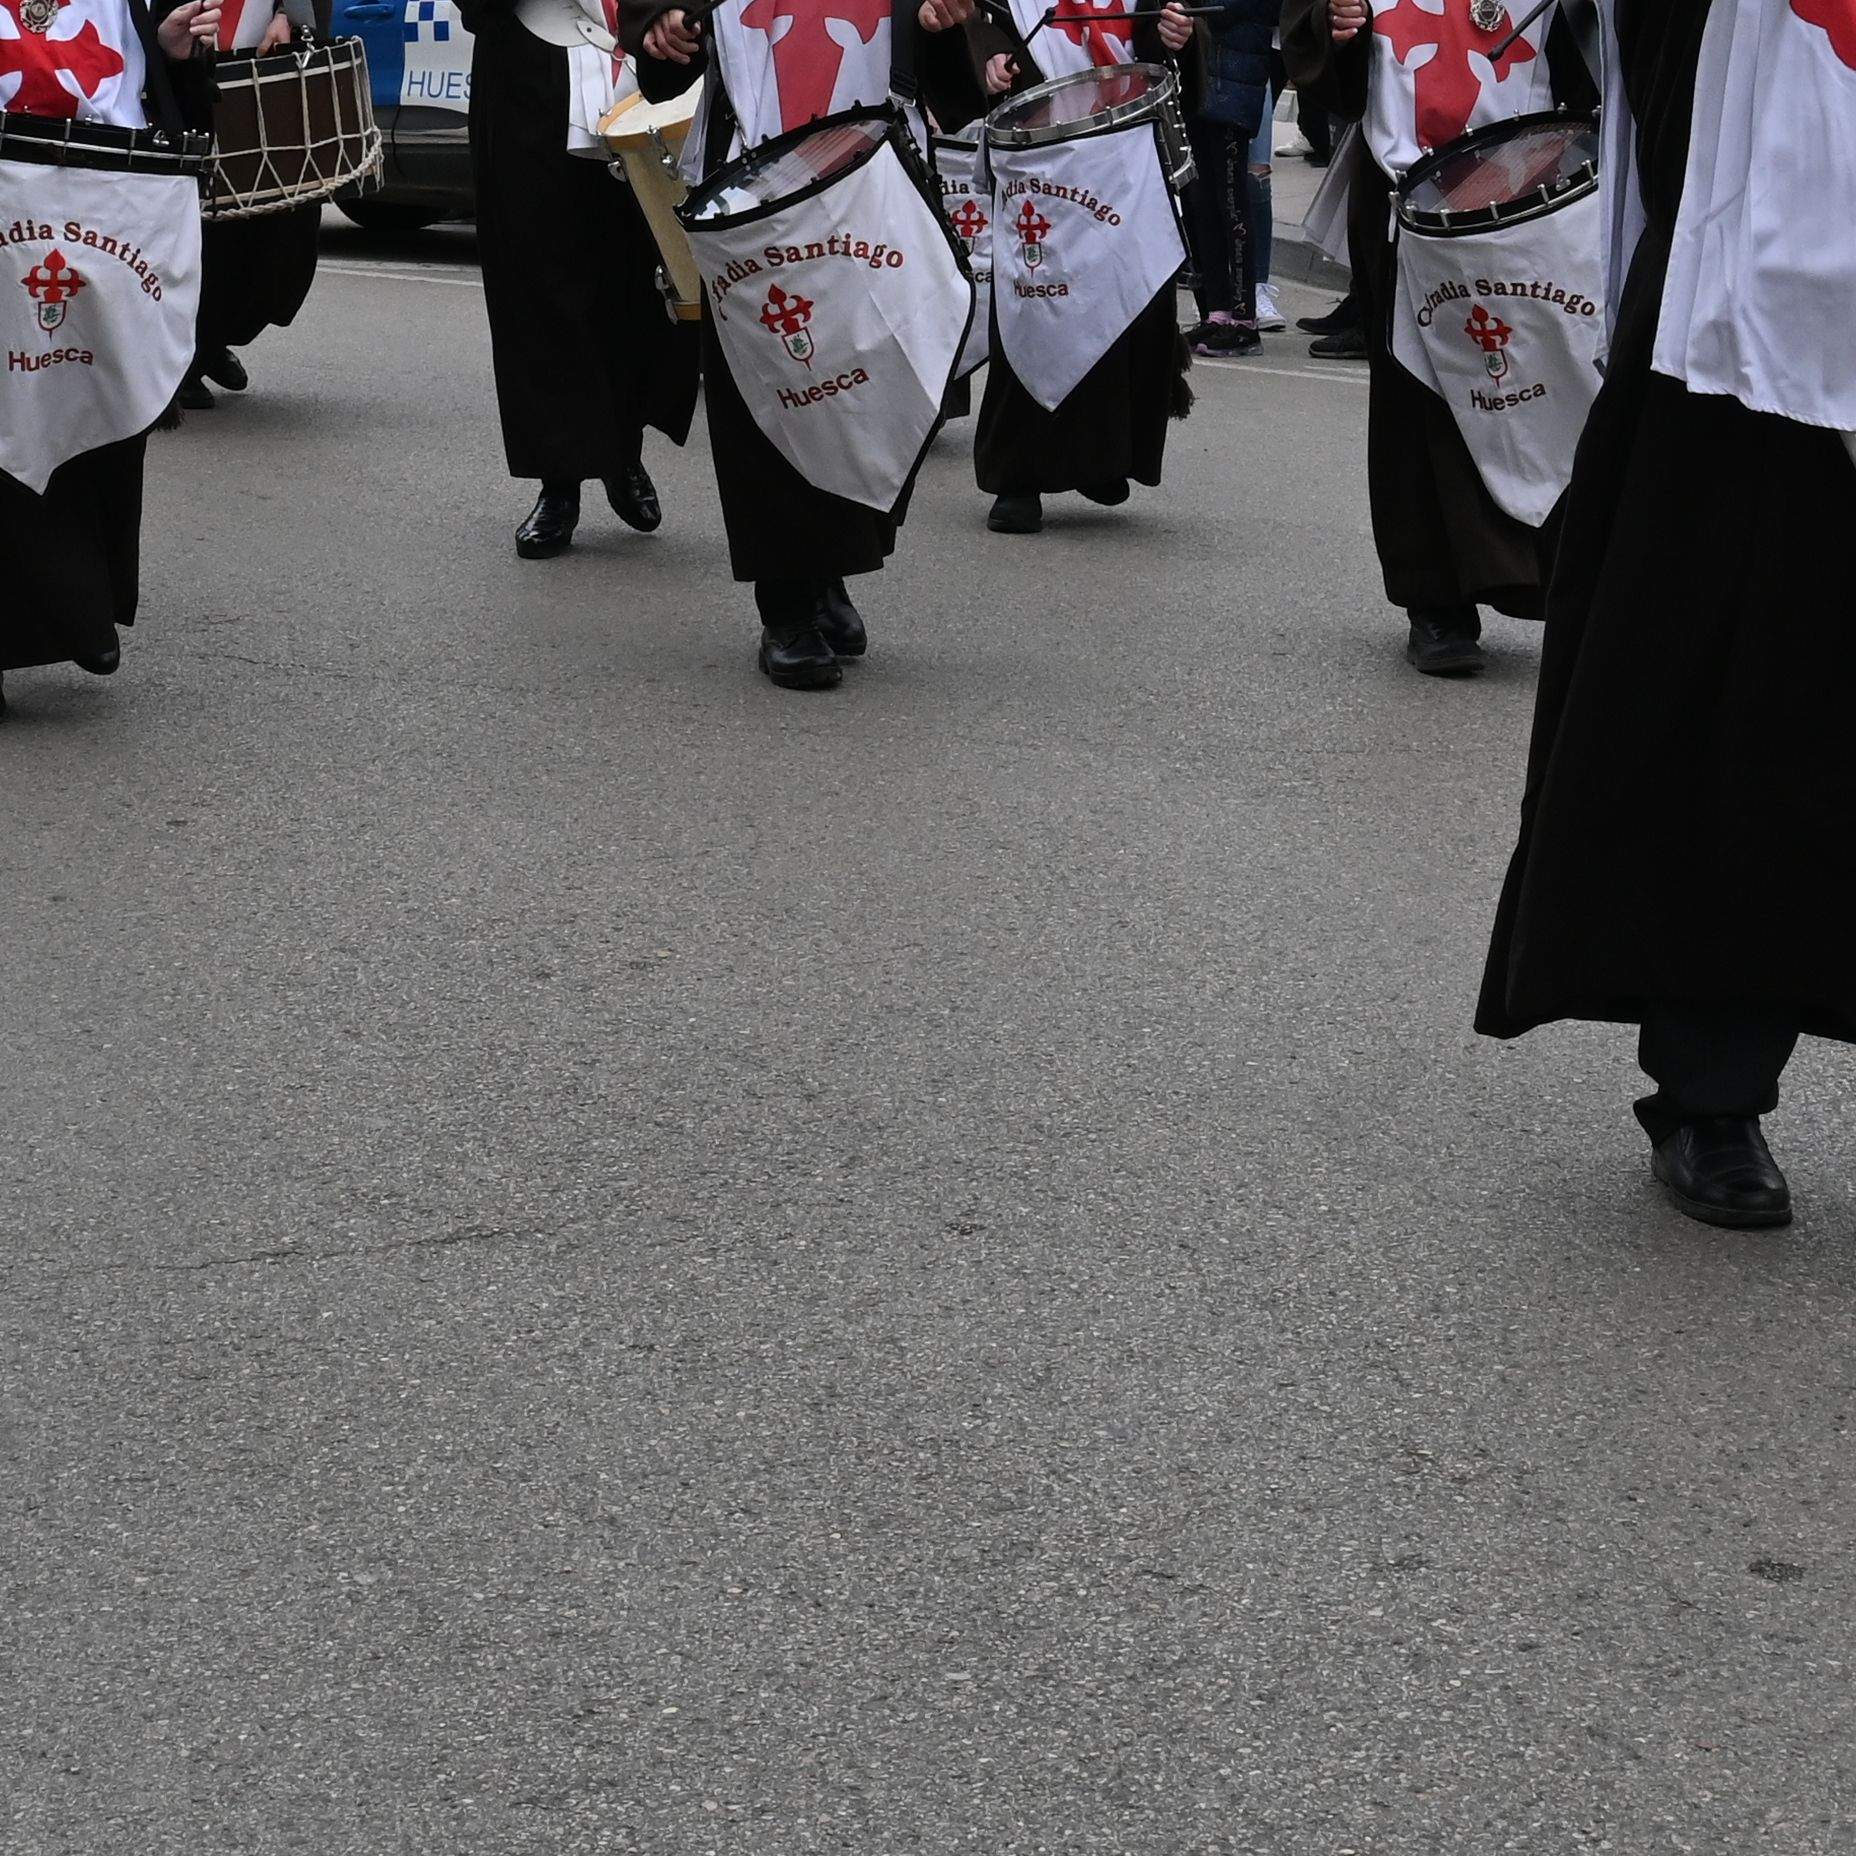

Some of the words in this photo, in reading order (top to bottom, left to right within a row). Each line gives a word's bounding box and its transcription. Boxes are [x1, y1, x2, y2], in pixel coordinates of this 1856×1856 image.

[1029, 177, 1122, 227] Santiago
[63, 221, 162, 302] Santiago
[763, 233, 904, 269] Santiago
[1474, 278, 1596, 317] Santiago
[8, 347, 93, 372] Huesca
[776, 367, 869, 409] Huesca
[1470, 382, 1546, 411] Huesca
